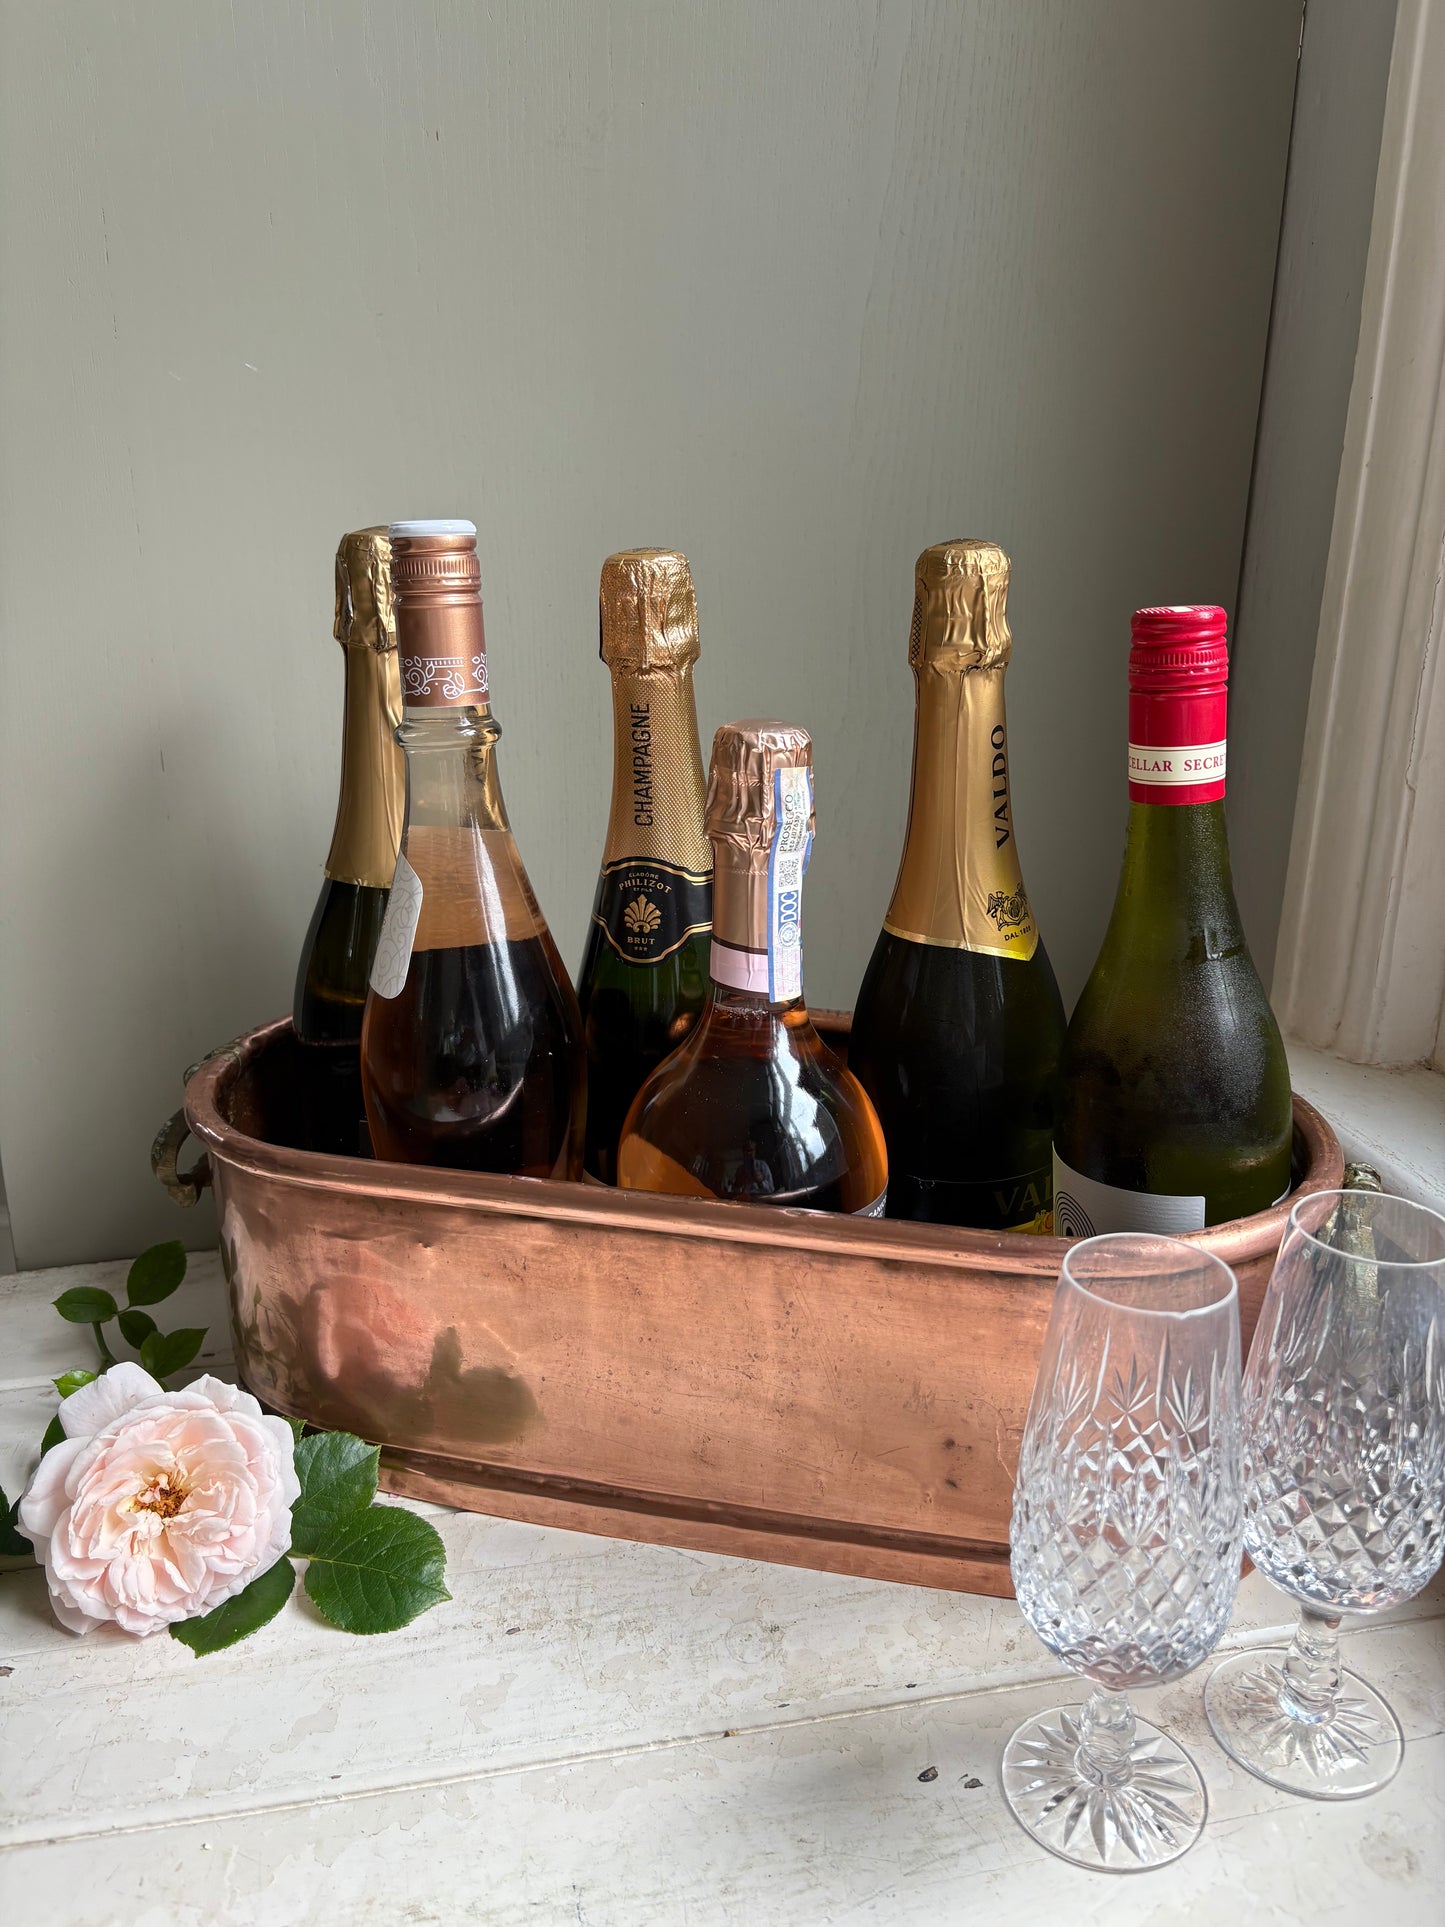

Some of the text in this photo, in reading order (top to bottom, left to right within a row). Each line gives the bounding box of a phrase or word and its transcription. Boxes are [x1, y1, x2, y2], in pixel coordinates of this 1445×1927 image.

[630, 703, 654, 827] CHAMPAGNE
[1183, 752, 1225, 772] SECRE
[990, 724, 1010, 849] VALDO
[779, 794, 795, 852] PROSECCO
[618, 878, 673, 894] PHILIZOT
[780, 890, 798, 924] DOC
[627, 936, 655, 945] BRUT
[1004, 931, 1019, 941] DAL
